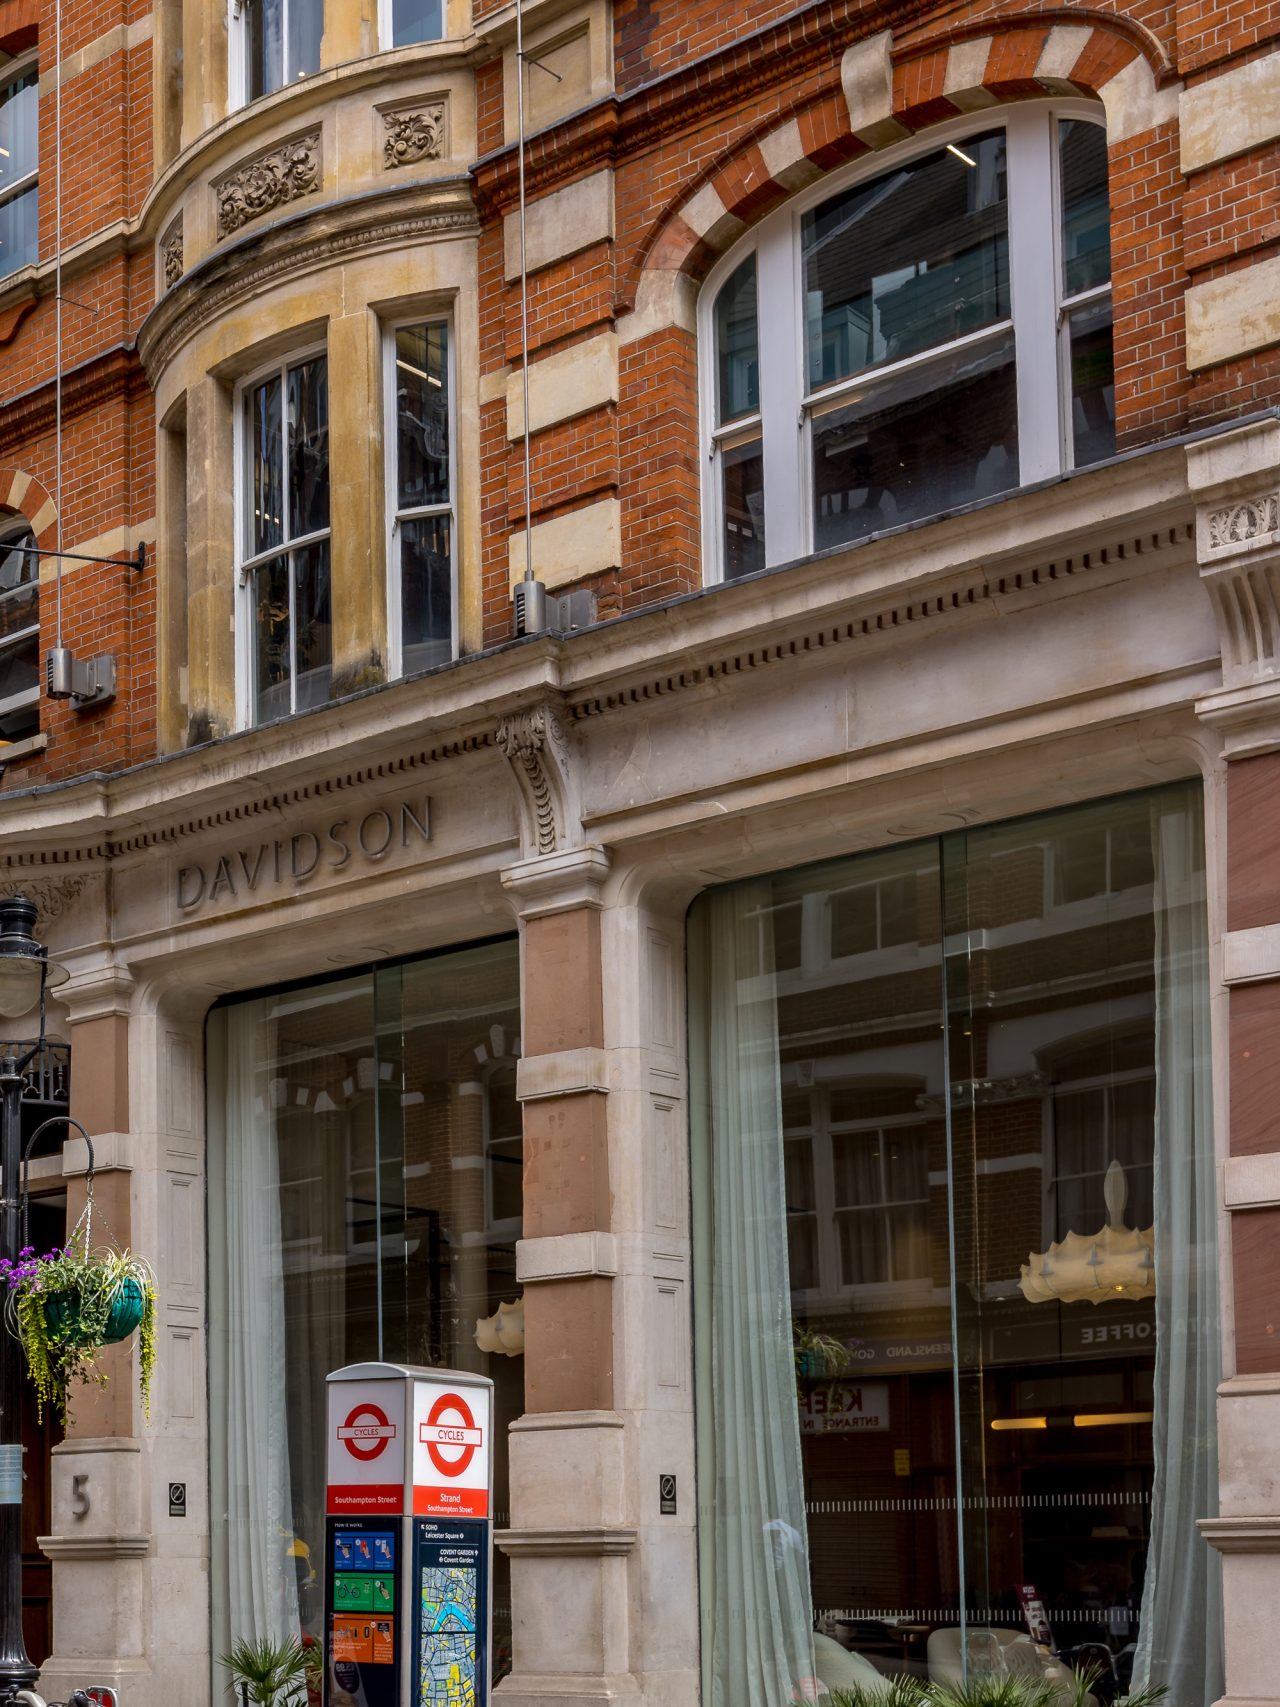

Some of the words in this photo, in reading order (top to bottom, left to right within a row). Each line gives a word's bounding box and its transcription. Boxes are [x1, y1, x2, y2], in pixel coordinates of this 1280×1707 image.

[177, 796, 434, 909] DAVIDSON
[354, 1428, 379, 1436] CYCLES
[437, 1429, 465, 1441] CYCLES
[72, 1474, 90, 1520] 5
[335, 1496, 376, 1504] Southampton
[440, 1493, 461, 1503] Strand
[427, 1504, 458, 1513] Southampton
